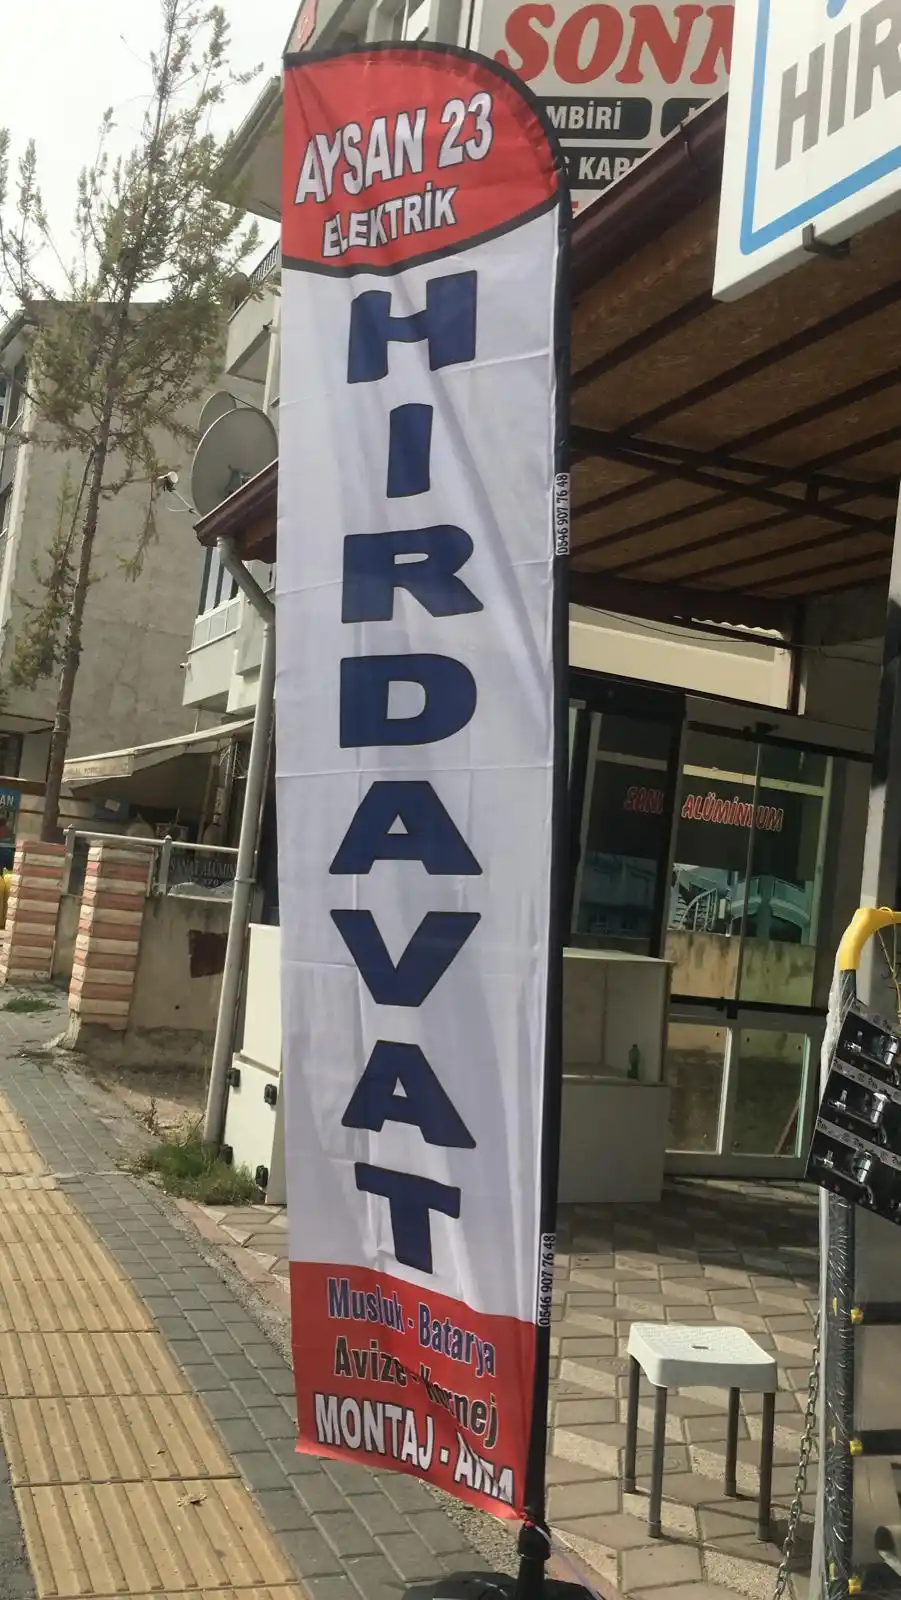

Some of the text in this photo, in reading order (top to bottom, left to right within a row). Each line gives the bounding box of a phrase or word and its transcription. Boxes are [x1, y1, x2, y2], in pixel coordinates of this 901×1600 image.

[294, 91, 493, 205] AYSAN 23
[321, 181, 459, 258] ELEKTRİK
[556, 474, 568, 554] 0546 907 76 48
[329, 270, 484, 1274] HIRDAVAT
[539, 1235, 556, 1326] 0546 907 76 48
[327, 1277, 405, 1334] Musluk
[418, 1302, 496, 1378] Batarya
[314, 1392, 434, 1470] MONTAJ
